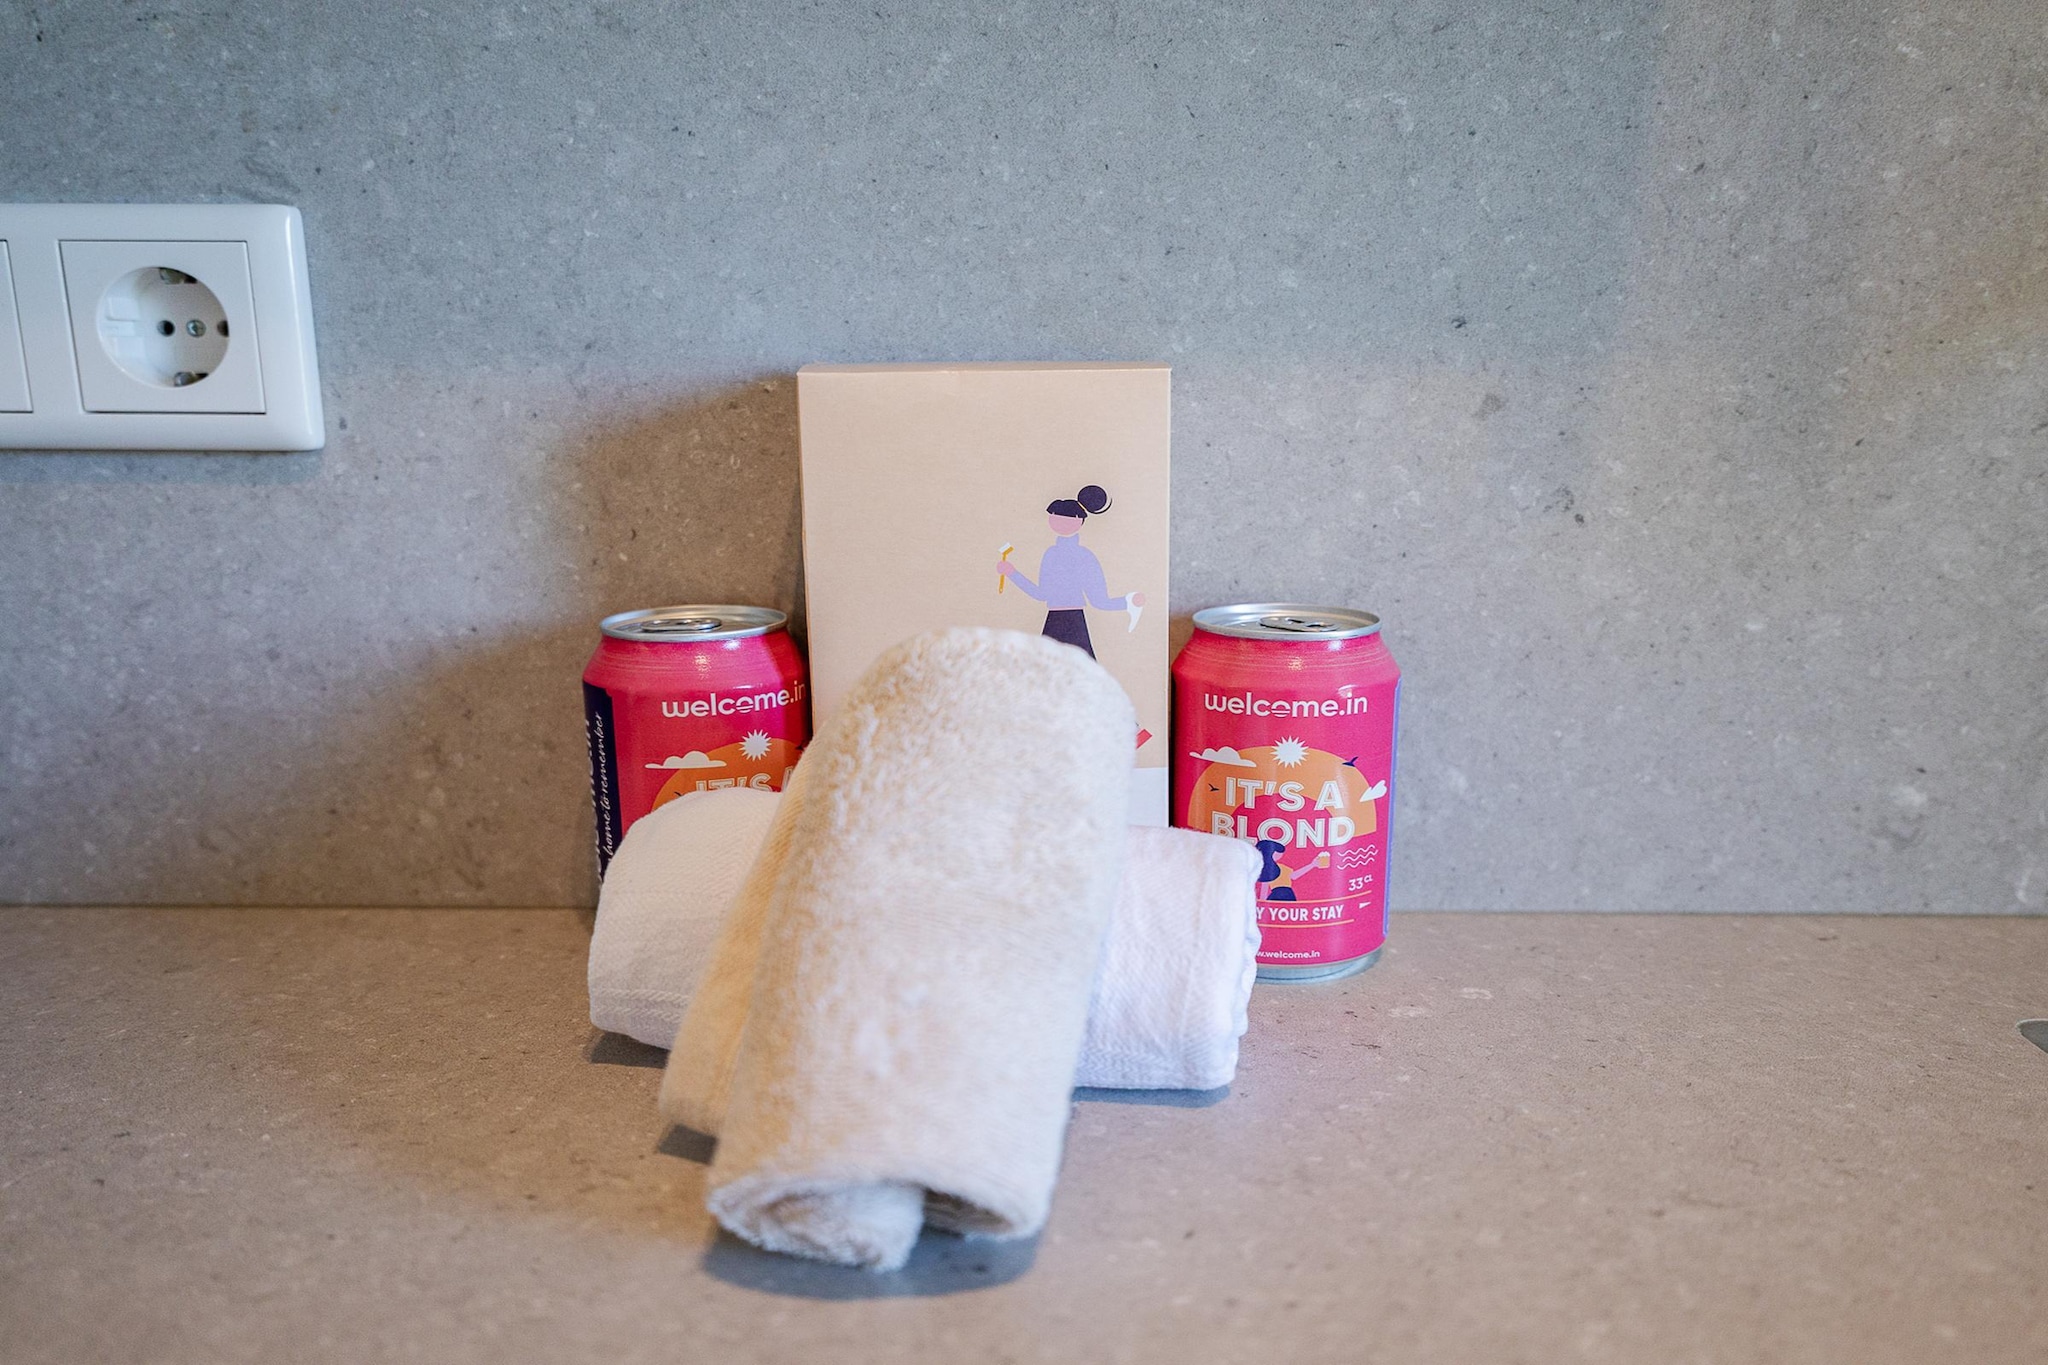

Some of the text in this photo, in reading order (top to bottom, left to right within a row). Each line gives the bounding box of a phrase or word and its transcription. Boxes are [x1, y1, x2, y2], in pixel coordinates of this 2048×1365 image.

[1203, 692, 1369, 718] welcome.in
[1225, 776, 1345, 812] IT'S A
[1211, 810, 1356, 849] BLOND
[1268, 907, 1309, 922] YOUR
[1312, 904, 1344, 921] STAY
[1256, 950, 1321, 959] w.welcome.in
